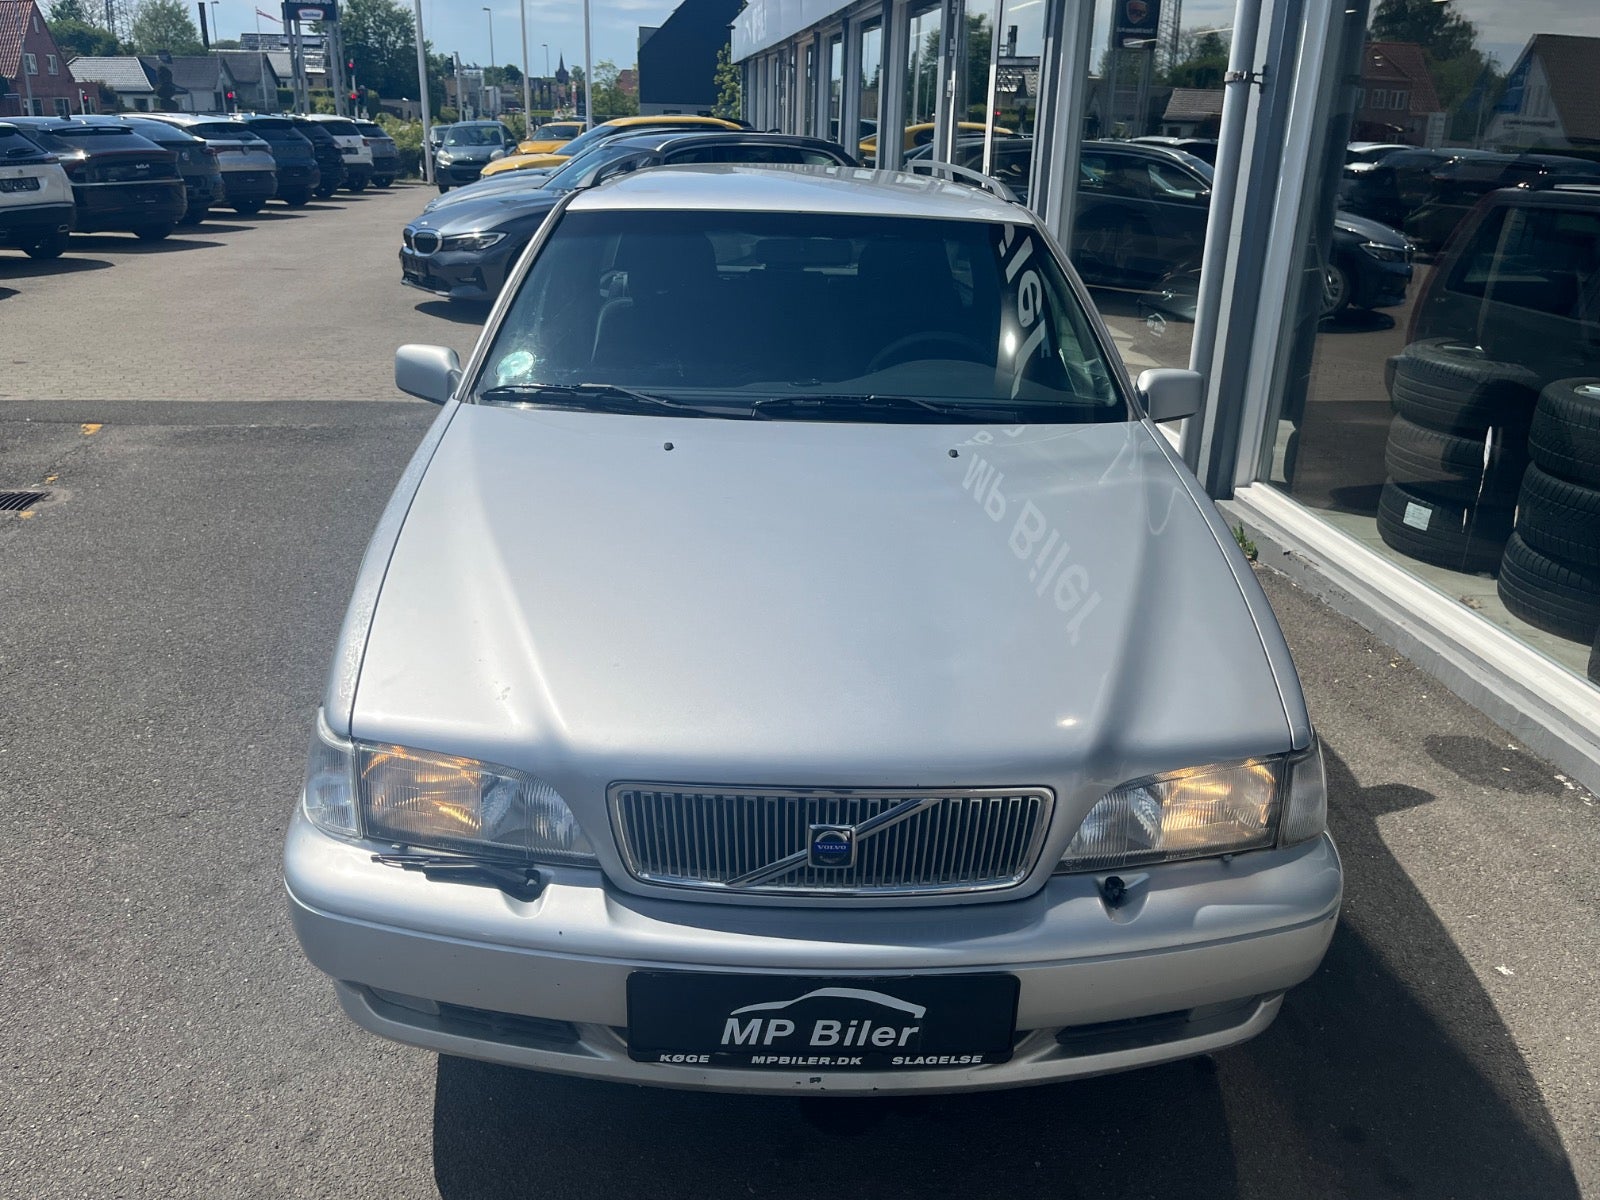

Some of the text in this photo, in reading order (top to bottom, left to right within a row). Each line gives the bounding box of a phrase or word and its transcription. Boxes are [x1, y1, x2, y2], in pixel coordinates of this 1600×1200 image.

[720, 1017, 920, 1047] MP Biler
[659, 1054, 710, 1063] KØGE
[751, 1055, 863, 1065] MPBILER.DK
[891, 1055, 983, 1065] SLAGELSE
